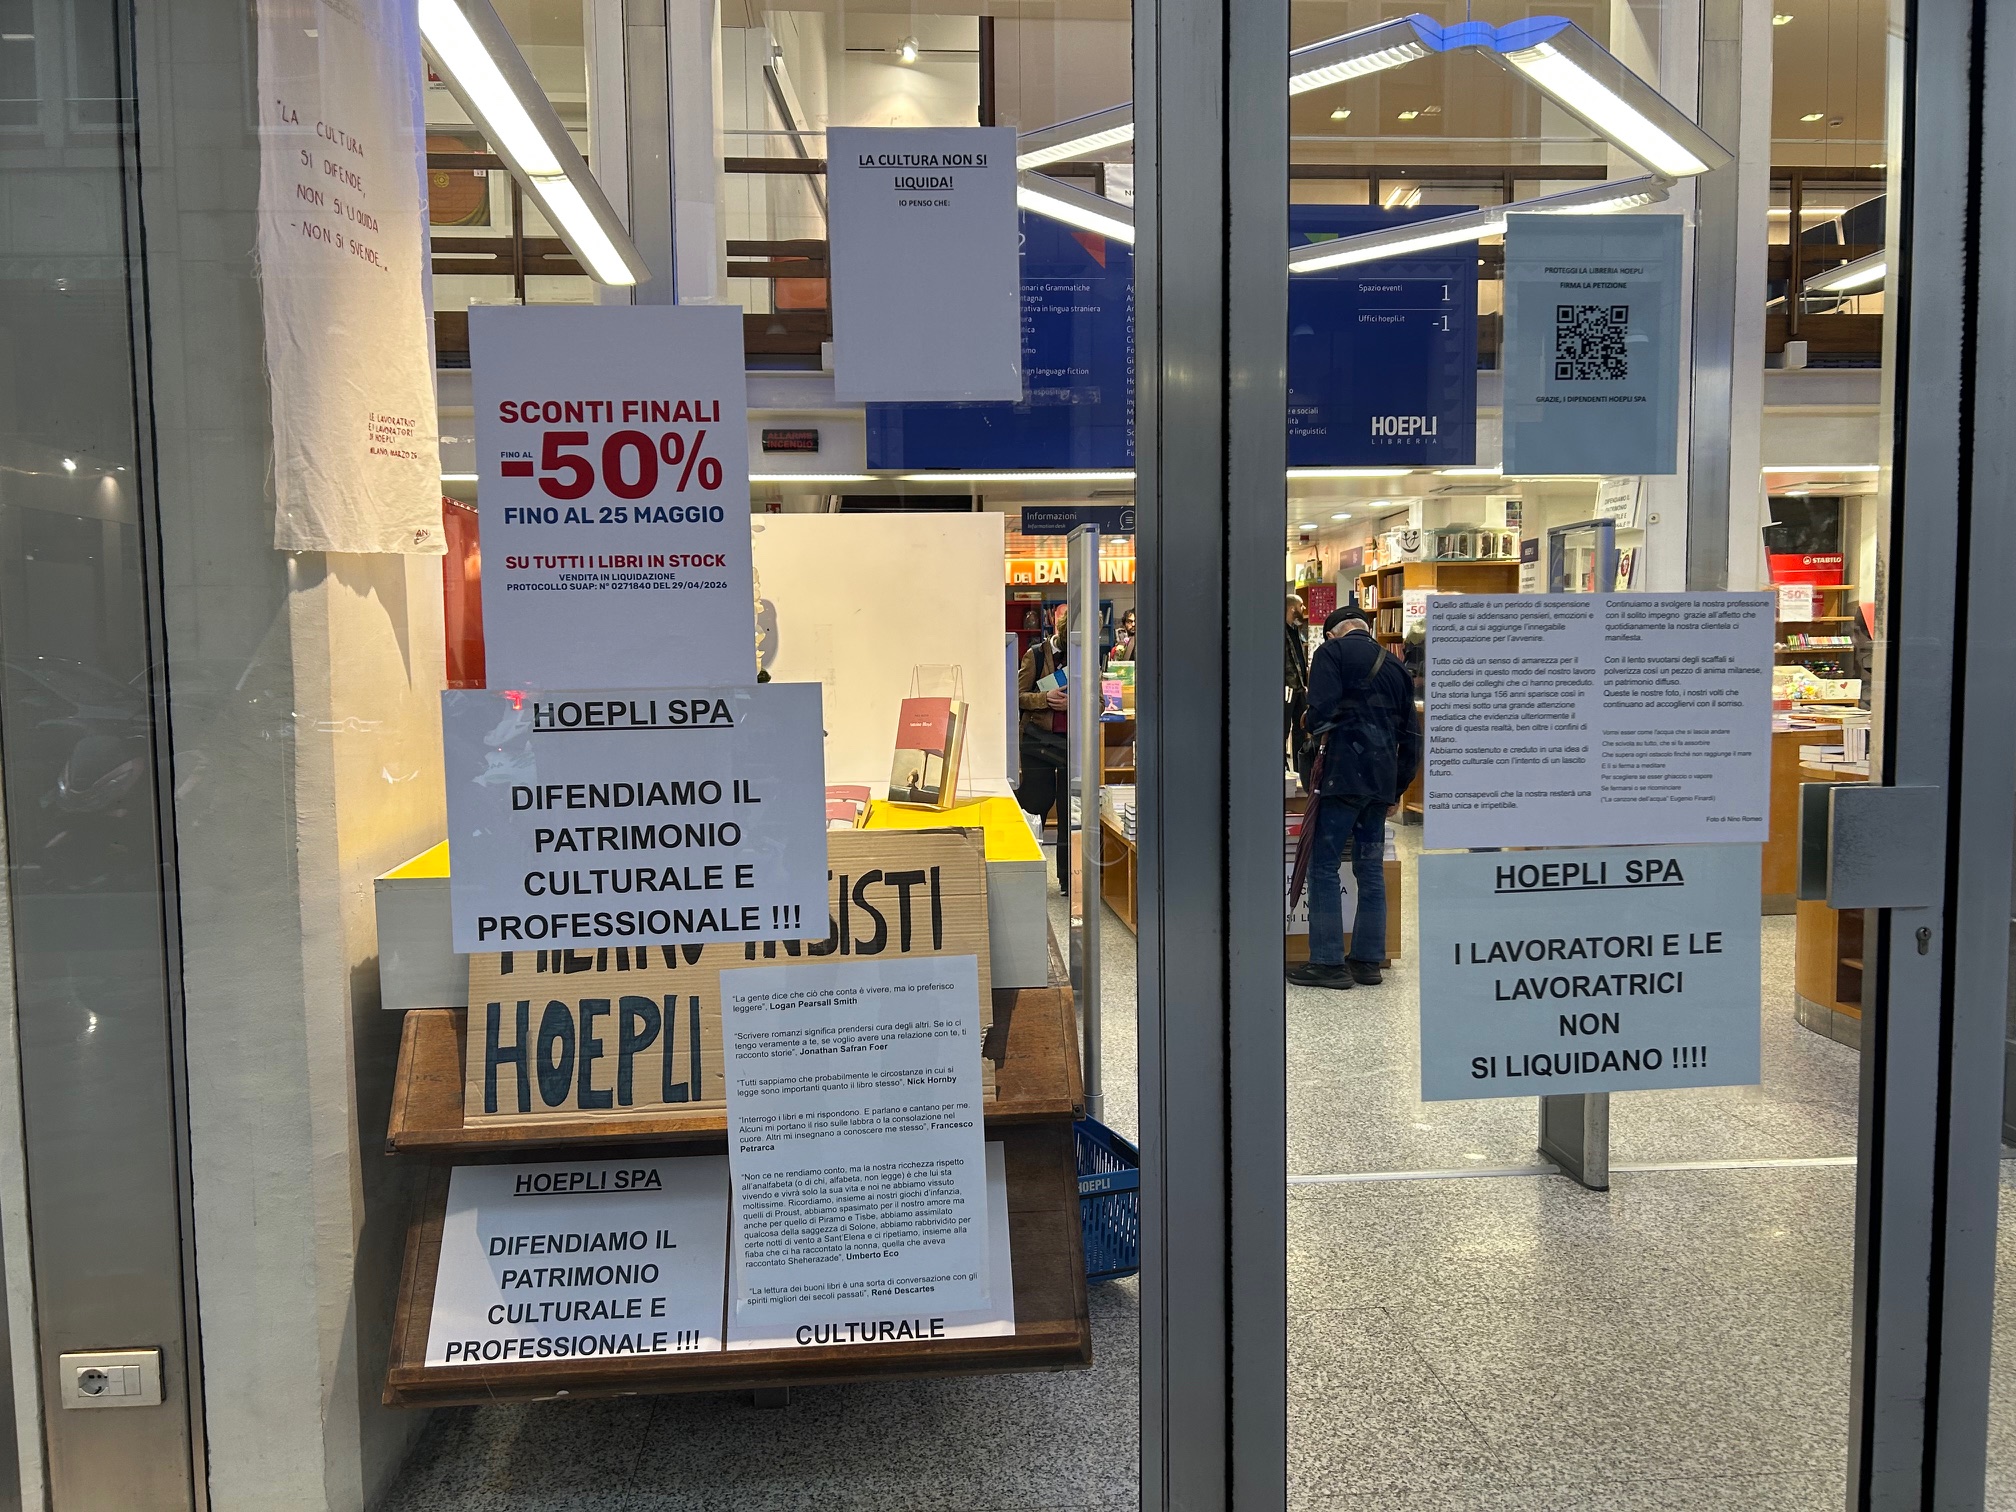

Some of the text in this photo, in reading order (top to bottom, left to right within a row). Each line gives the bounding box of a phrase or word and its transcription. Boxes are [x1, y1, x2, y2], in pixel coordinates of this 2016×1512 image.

[316, 121, 364, 158] CULTURA
[300, 149, 313, 169] SI
[858, 154, 988, 167] LA CULTURA NON SI
[894, 176, 953, 189] LIQUIDA!
[297, 184, 324, 206] NON
[333, 198, 343, 215] SI
[898, 199, 950, 207] IO PENSO CHE:
[302, 221, 331, 243] NON
[335, 233, 344, 248] SI
[1589, 267, 1618, 275] LIBRERIA
[1620, 267, 1644, 275] HOEPLI
[1045, 283, 1091, 291] Grammatiche
[1358, 284, 1451, 301] Spazio eventi 1
[1049, 305, 1069, 314] lingua
[1432, 315, 1450, 331] -1
[1035, 367, 1066, 376] language
[1536, 396, 1562, 404] GRAZIE,
[499, 400, 720, 424] SCONTI FINALI
[1296, 407, 1319, 415] sociali
[767, 432, 813, 440] ALLARME
[1294, 427, 1327, 437] linguistici
[1371, 416, 1437, 436] HOEPLI
[767, 440, 813, 448] INCENDIO
[501, 430, 723, 500] -50%
[504, 505, 724, 525] FINO AL 25 MAGGIO
[1027, 511, 1077, 521] Informazioni
[505, 554, 726, 570] SU TUTTI I LIBRI IN STOCK
[1812, 556, 1842, 564] STABILO
[558, 572, 676, 581] VENDITA IN LIQUIDAZIONE
[1013, 572, 1032, 584] DEI
[1034, 560, 1129, 584] BAINI
[506, 583, 568, 591] PROTOCOLLO
[569, 583, 598, 591] SUAP:
[611, 582, 651, 590] 0271840
[653, 581, 671, 590] DEL
[672, 581, 728, 590] 29/04/2026
[1406, 605, 1426, 615] -50
[1432, 601, 1458, 609] Quello
[1458, 601, 1485, 609] attuale
[1504, 600, 1533, 610] periodo
[1534, 600, 1542, 608] di
[1543, 600, 1590, 610] sospensione
[533, 698, 734, 730] HOEPLI SPA
[512, 779, 761, 811] DIFENDIAMO IL
[535, 821, 741, 853] PATRIMONIO
[524, 864, 755, 897] CULTURALE E
[1495, 858, 1684, 889] HOEPLI SPA
[478, 904, 801, 942] PROFESSIONALE !!!
[1455, 932, 1723, 965] I LAVORATORI E LE
[747, 994, 770, 1004] gente
[771, 992, 788, 1000] dice
[789, 991, 804, 999] che
[806, 990, 818, 998] ciò
[819, 989, 834, 997] che
[836, 988, 857, 996] conta
[859, 986, 865, 995] è
[866, 986, 892, 995] vivere,
[907, 984, 915, 992] io
[916, 983, 955, 993] preferisco
[1495, 971, 1683, 1002] LAVORATRICI
[769, 1002, 796, 1011] Logan
[798, 998, 832, 1008] Pearsall
[833, 997, 858, 1006] Smith
[1559, 1012, 1620, 1037] NON
[484, 994, 702, 1114] HOEPLI
[1471, 1045, 1707, 1080] SI LIQUIDANO !!!!
[515, 1168, 662, 1193] HOEPLI SPA
[489, 1229, 677, 1257] DIFENDIAMO IL
[501, 1263, 659, 1290] PATRIMONIO
[487, 1297, 666, 1325] CULTURALE E
[796, 1318, 945, 1346] CULTURALE
[445, 1329, 700, 1363] PROFESSIONALE !!!
